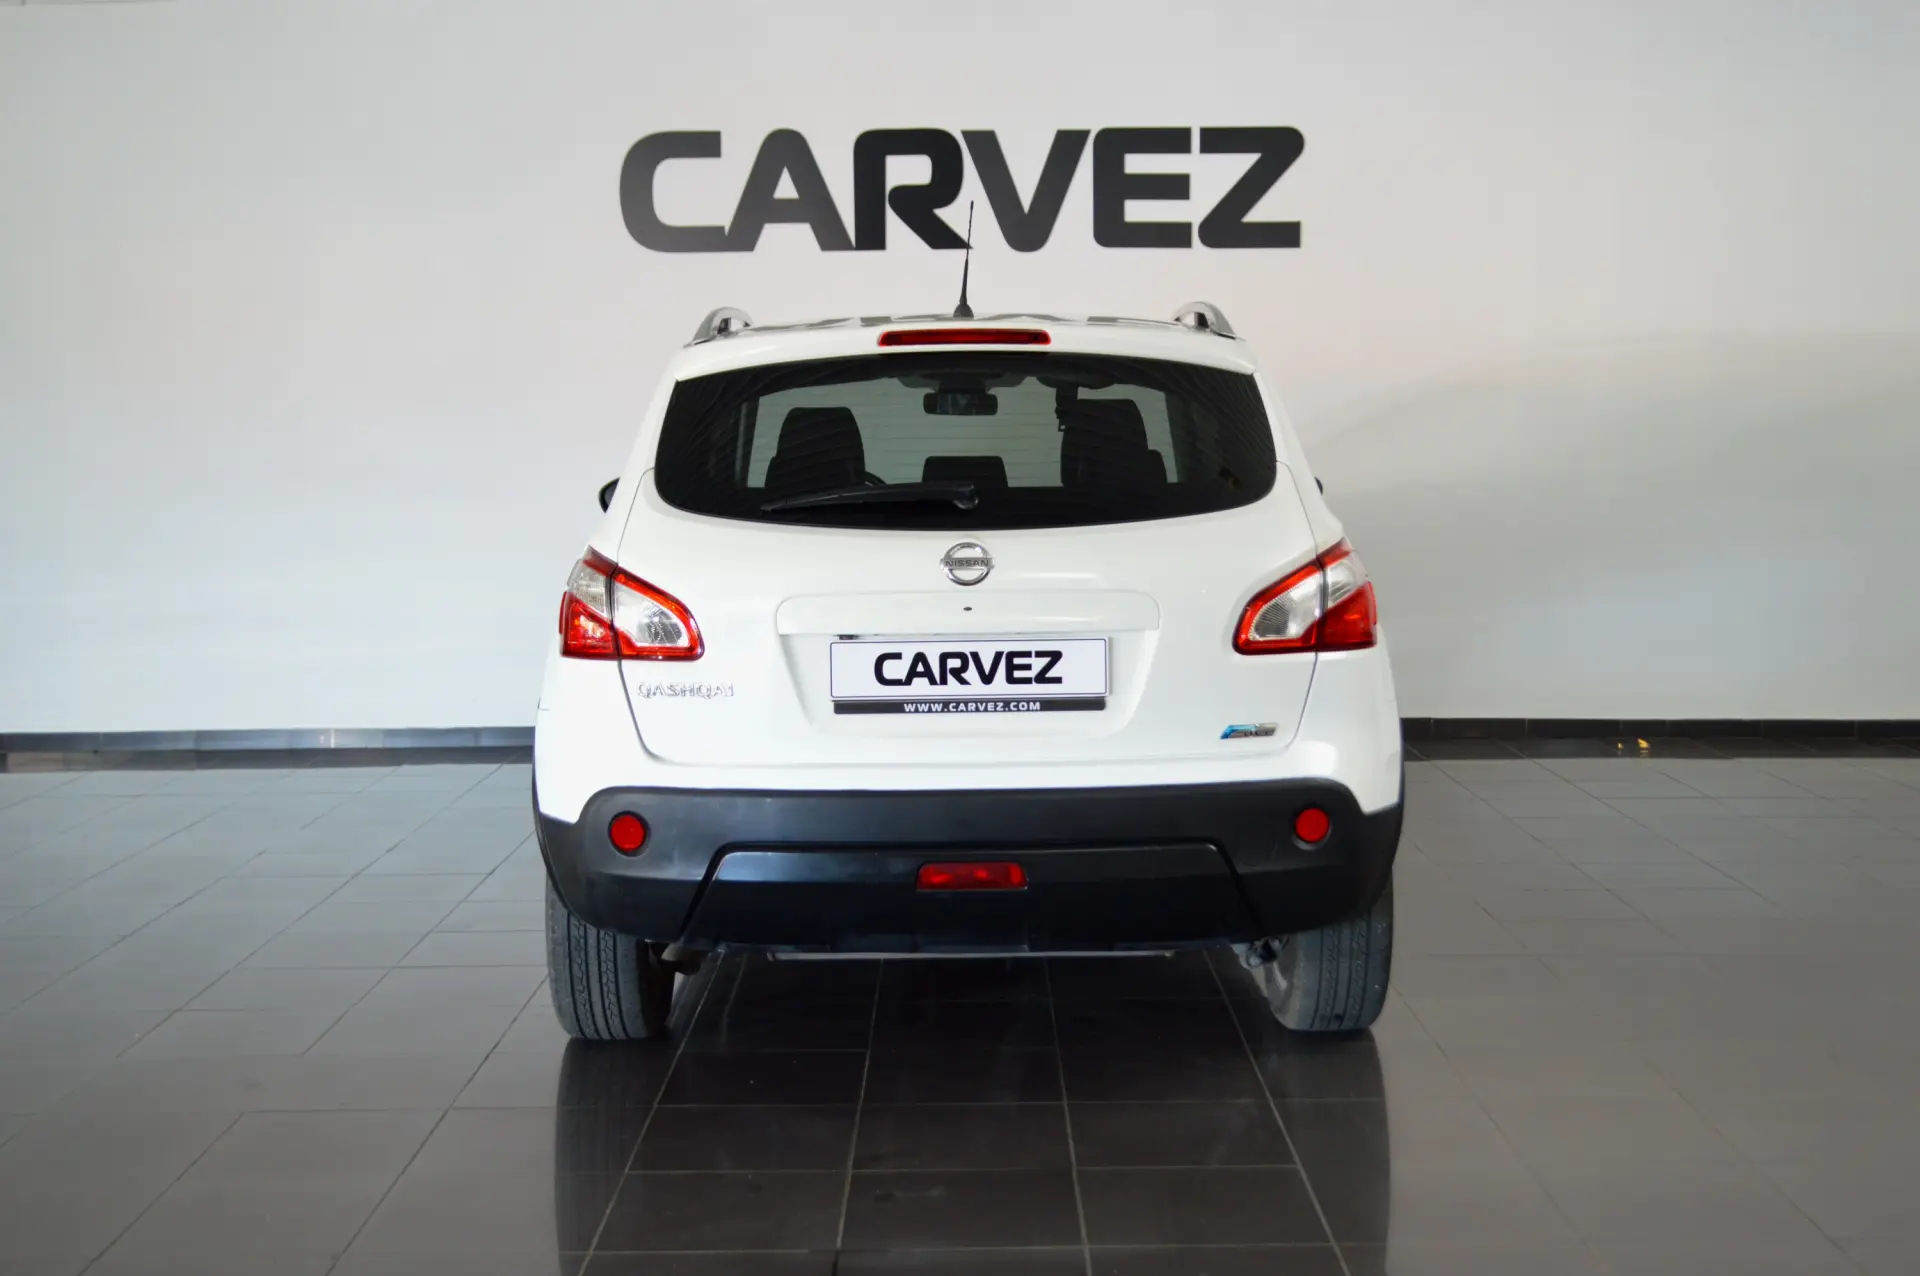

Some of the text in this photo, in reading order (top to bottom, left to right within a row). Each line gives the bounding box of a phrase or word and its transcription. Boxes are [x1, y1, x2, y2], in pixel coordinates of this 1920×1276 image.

[619, 126, 1305, 252] CARVEZ
[945, 559, 989, 567] NISSAN
[874, 650, 1063, 686] CARVEZ
[638, 683, 734, 699] QASHQAI
[903, 701, 1041, 712] WWW.CARVEZ.COM
